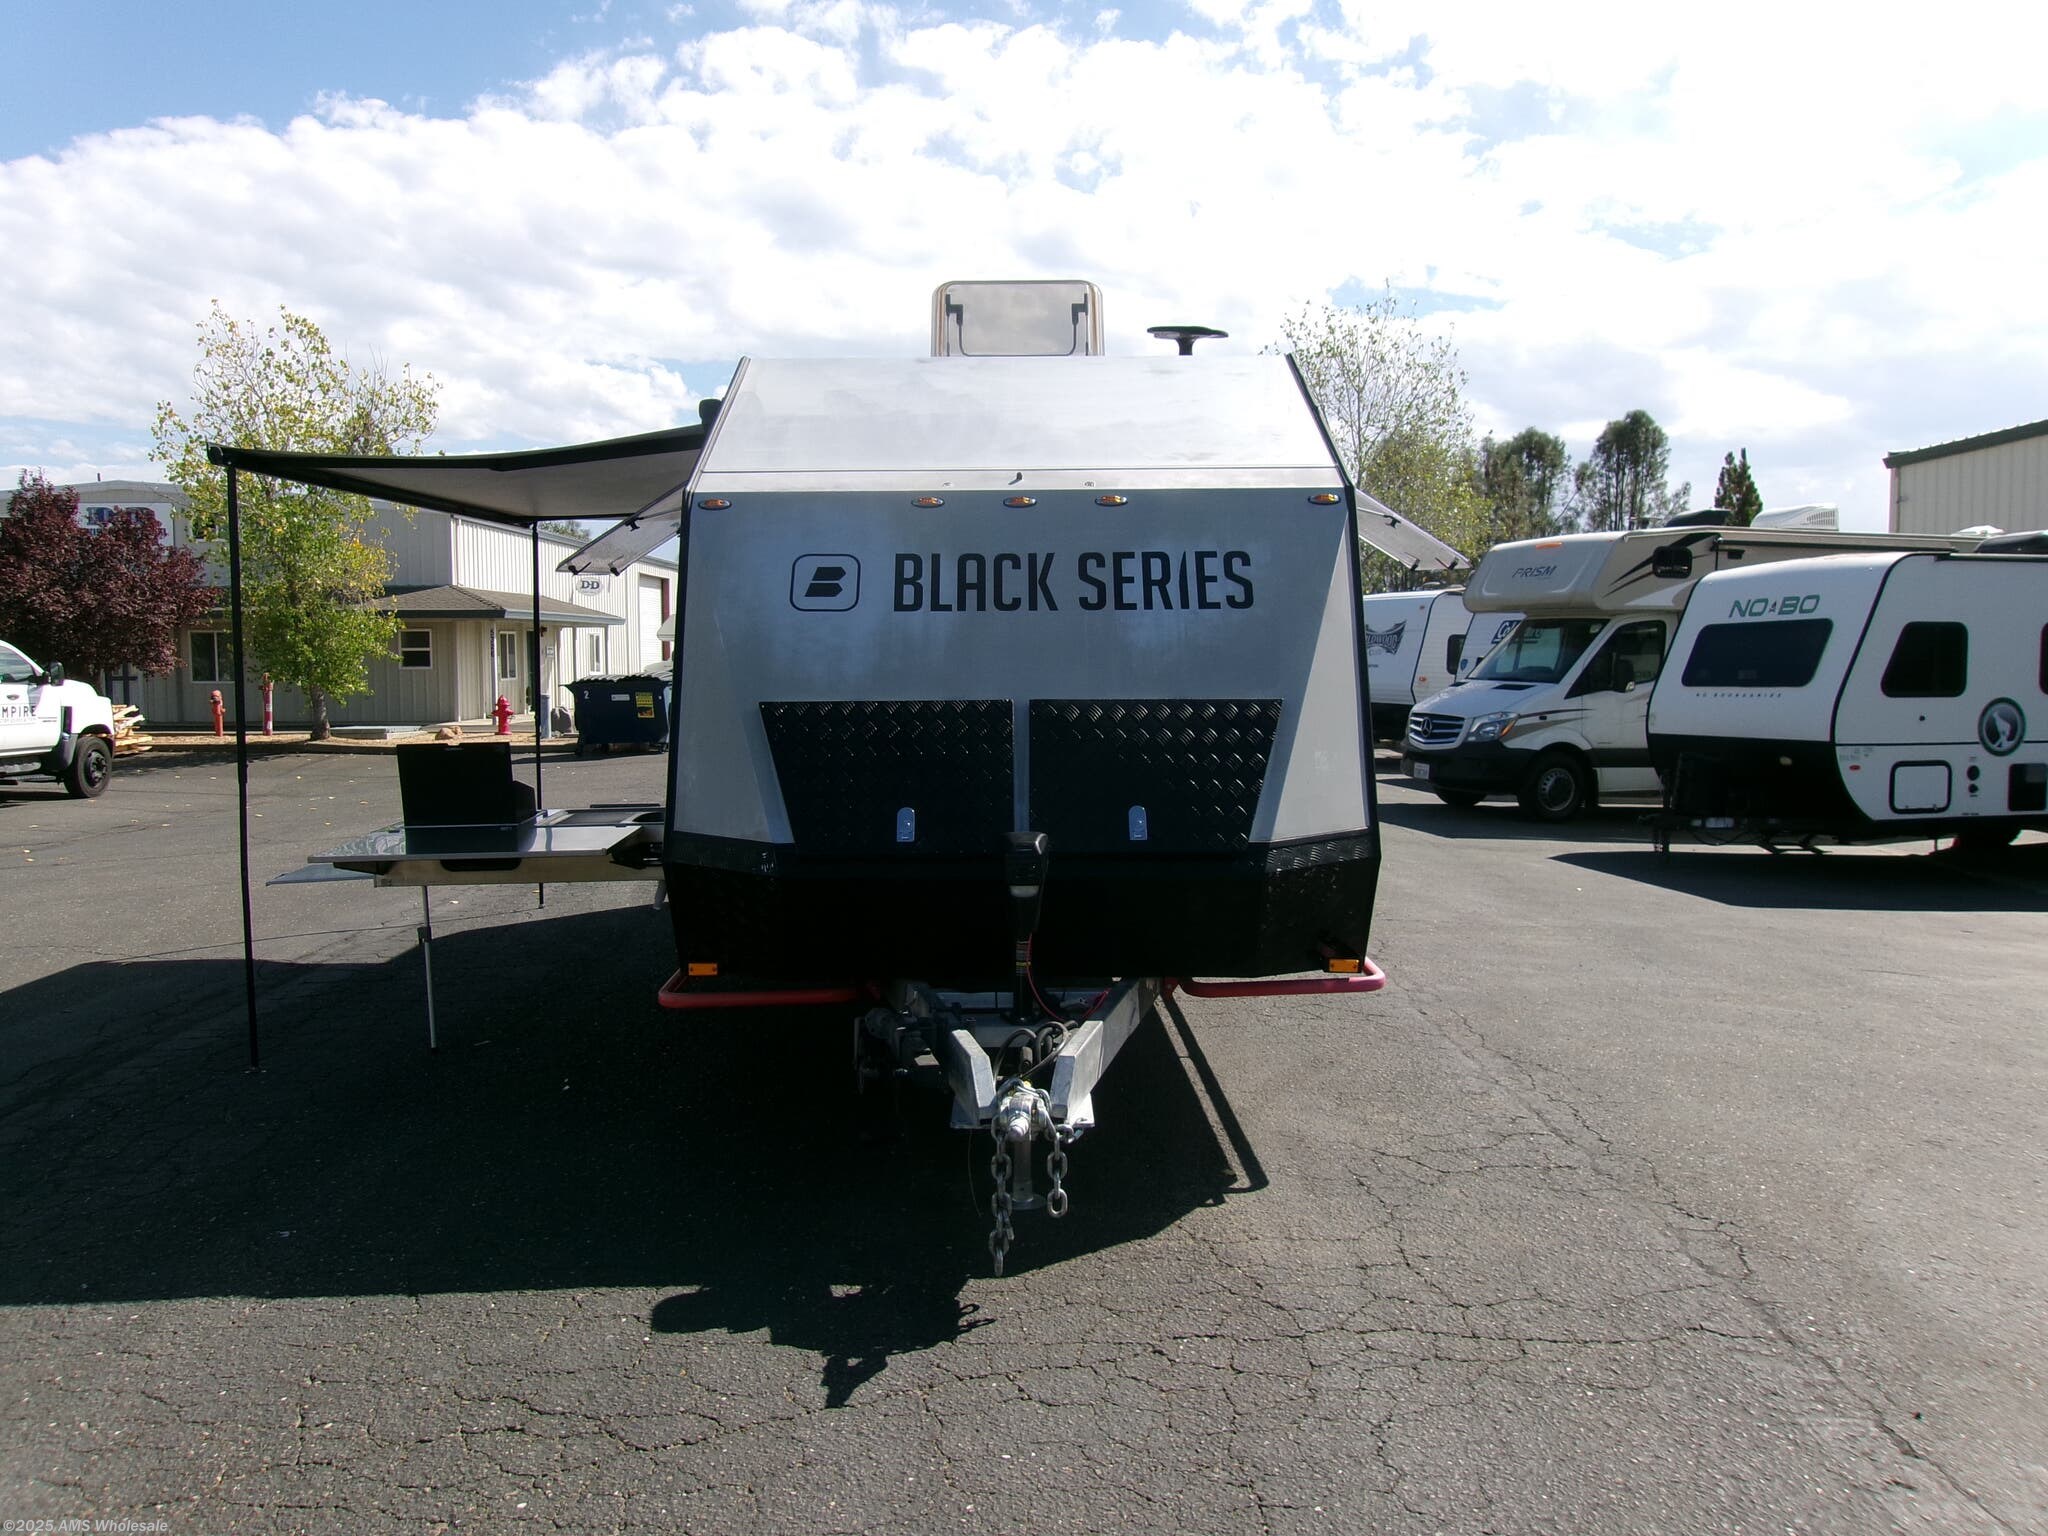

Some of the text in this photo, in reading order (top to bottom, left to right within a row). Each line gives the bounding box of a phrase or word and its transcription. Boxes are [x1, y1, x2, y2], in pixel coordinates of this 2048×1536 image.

[1511, 565, 1557, 578] PRISM
[893, 550, 1254, 612] BLACK SERIES
[583, 690, 590, 699] 2
[1, 705, 37, 718] MPIRE
